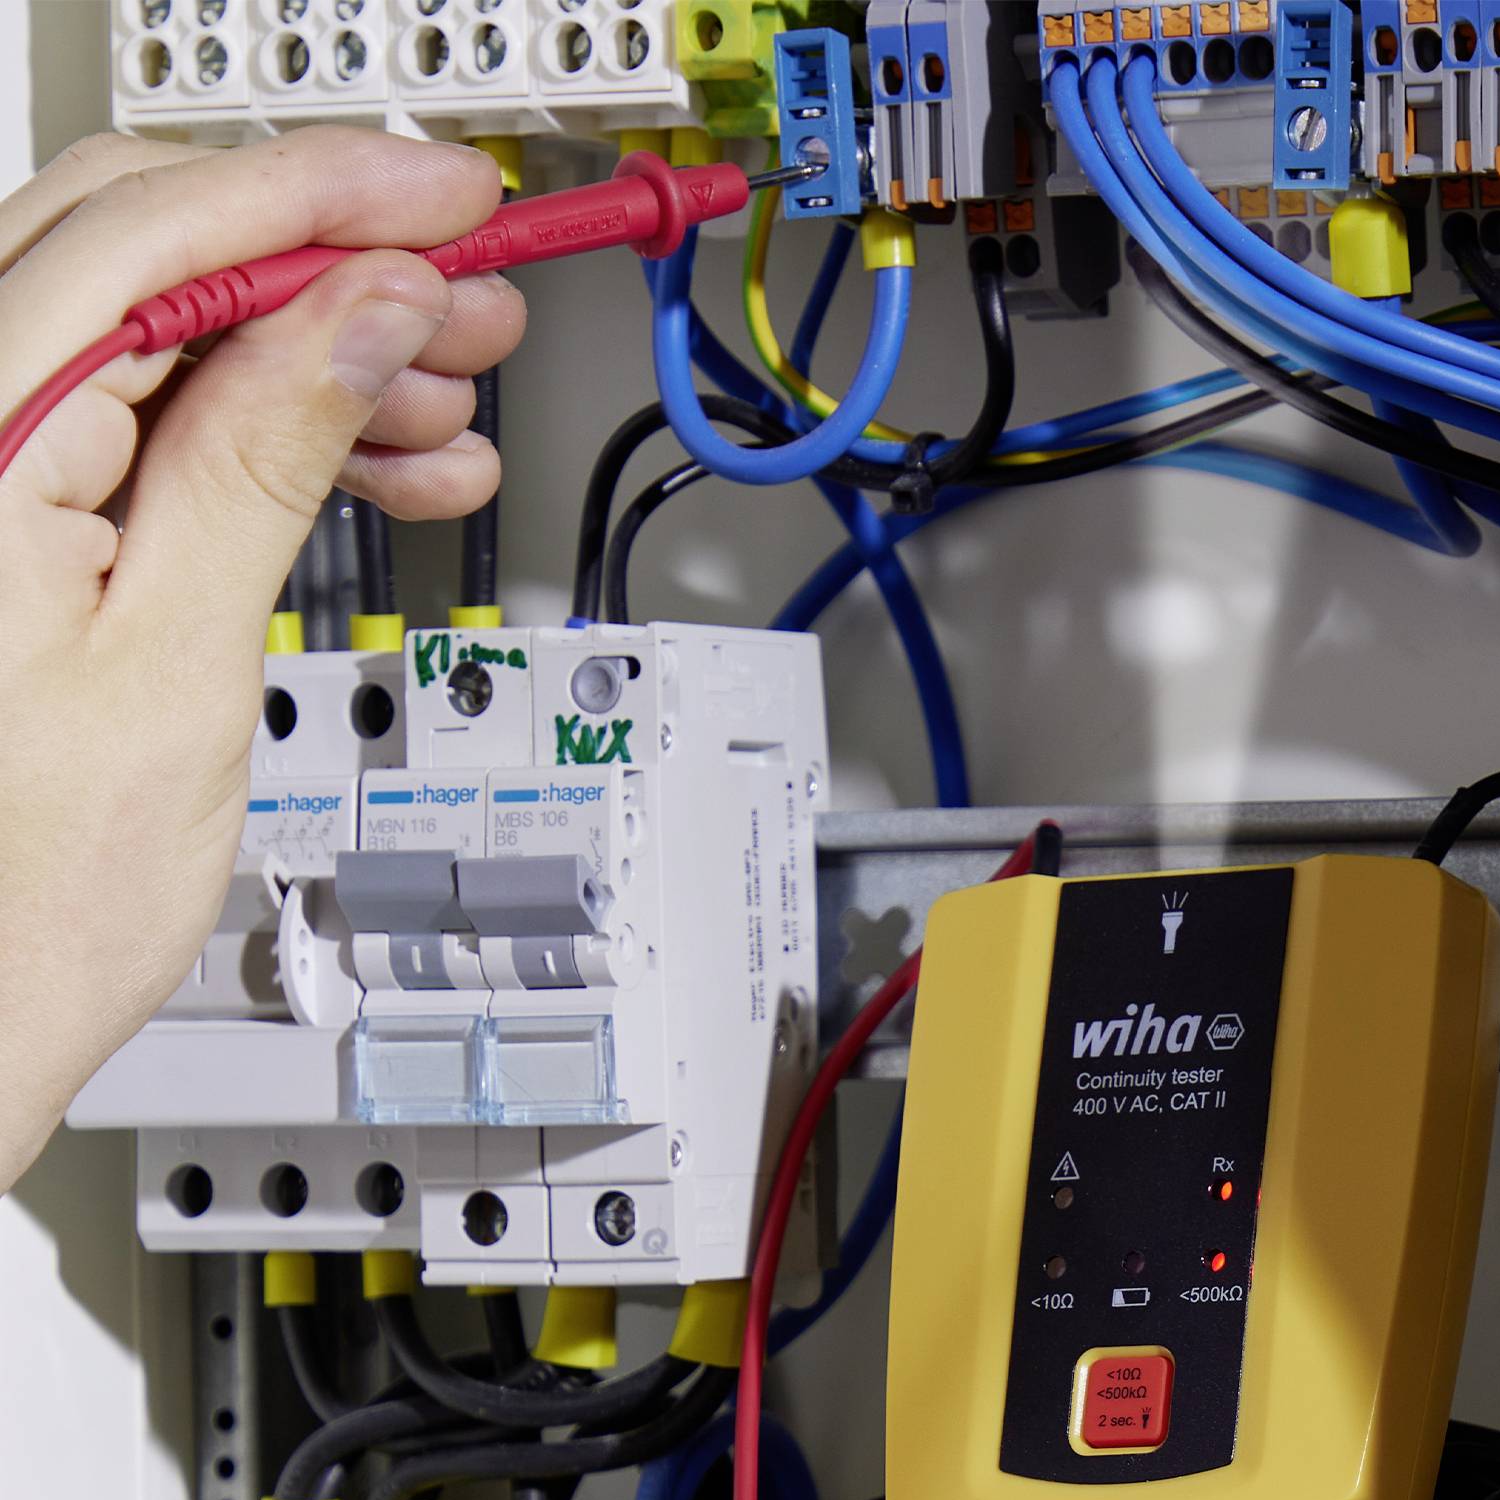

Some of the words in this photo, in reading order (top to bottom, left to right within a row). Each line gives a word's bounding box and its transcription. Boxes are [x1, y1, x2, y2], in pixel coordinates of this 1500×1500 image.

[411, 818, 436, 834] 116
[494, 811, 534, 828] MBS
[540, 810, 568, 827] 106
[494, 831, 518, 847] B6
[1072, 1003, 1202, 1058] wiha
[1076, 1069, 1166, 1091] Continuity
[1172, 1067, 1224, 1085] tester
[1073, 1097, 1107, 1115] 400
[1113, 1097, 1128, 1113] V
[1129, 1094, 1163, 1114] AC,
[1170, 1092, 1210, 1110] CAT
[1215, 1090, 1227, 1108] II
[1212, 1157, 1235, 1173] Rx
[1031, 1293, 1075, 1309] <10Ω
[1179, 1285, 1243, 1303] <500kΩ
[1106, 1368, 1141, 1381] <10Ω
[1096, 1386, 1147, 1400] <500kΩ
[1097, 1414, 1107, 1427] 2
[1110, 1415, 1136, 1427] sec.
